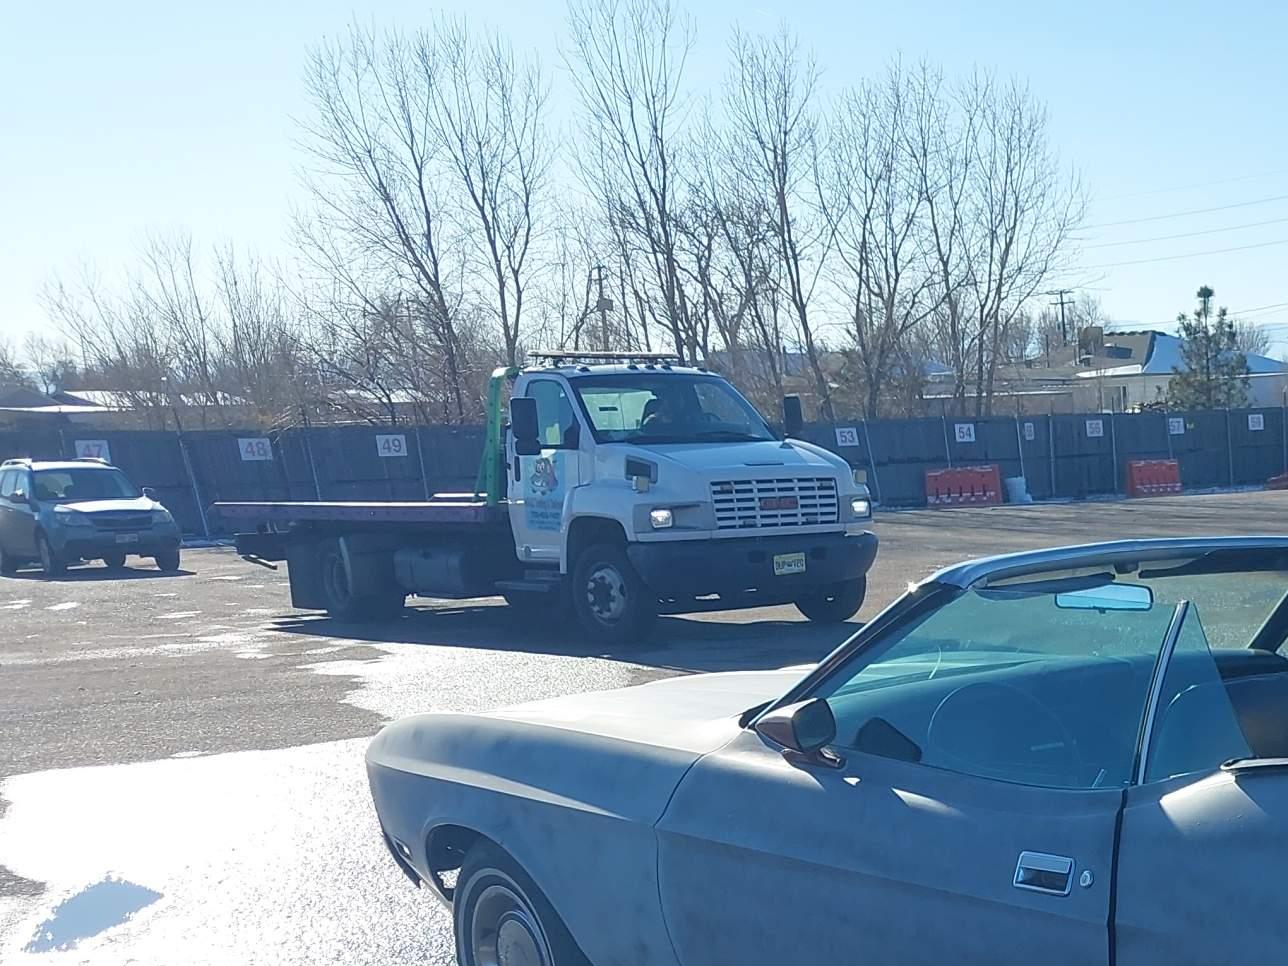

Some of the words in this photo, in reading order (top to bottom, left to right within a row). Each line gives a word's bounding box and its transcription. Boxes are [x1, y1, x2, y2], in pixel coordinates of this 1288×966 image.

[839, 430, 855, 444] 53
[958, 426, 972, 440] 54
[83, 444, 104, 458] 47
[244, 441, 266, 457] 48
[382, 437, 401, 454] 49
